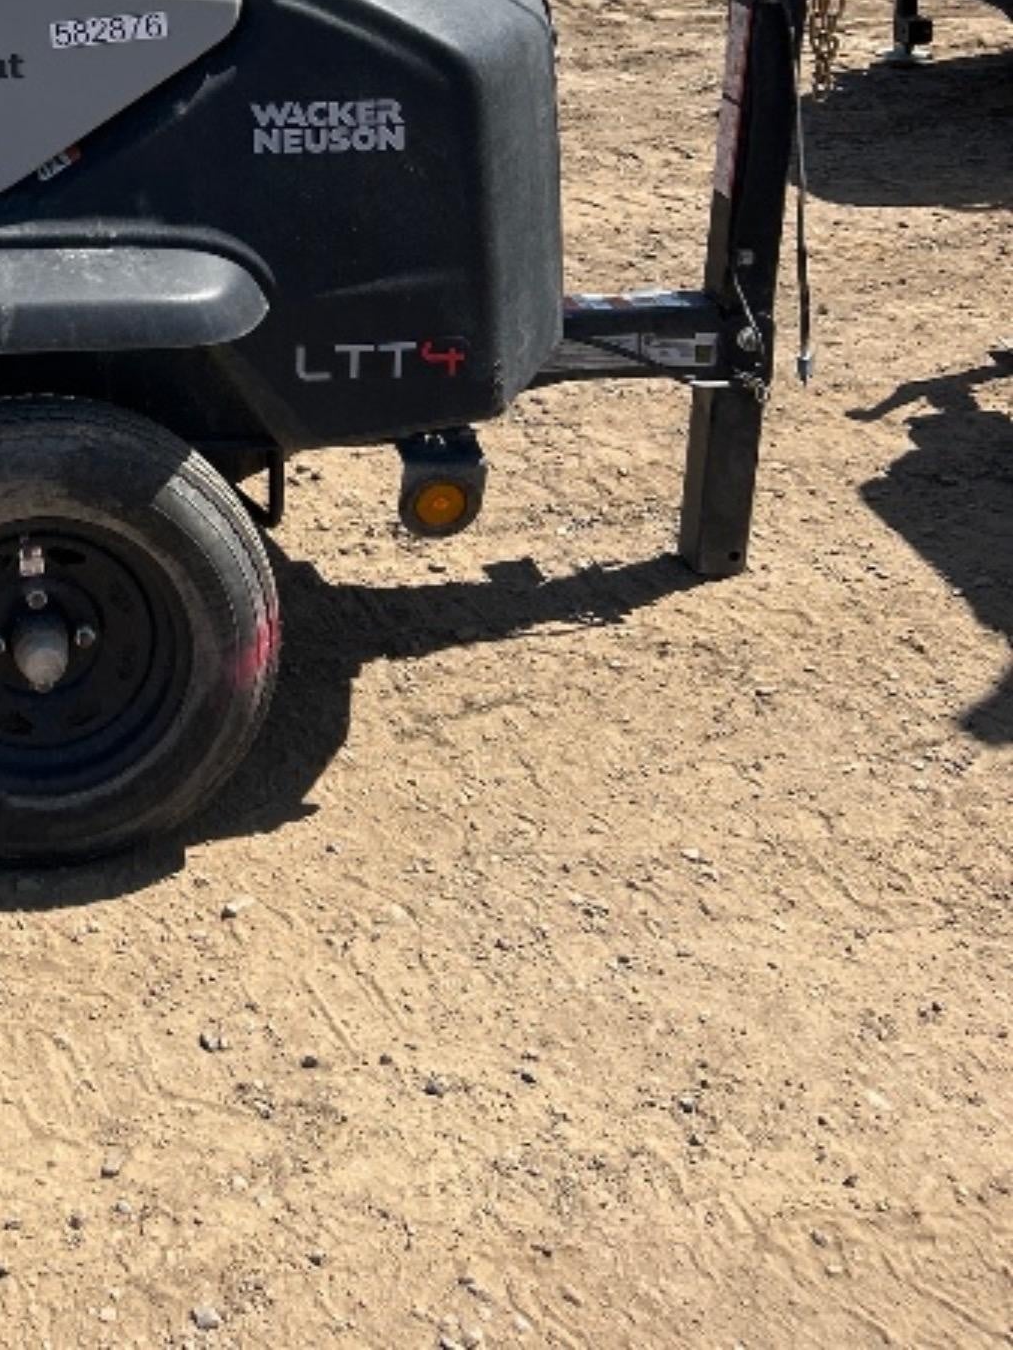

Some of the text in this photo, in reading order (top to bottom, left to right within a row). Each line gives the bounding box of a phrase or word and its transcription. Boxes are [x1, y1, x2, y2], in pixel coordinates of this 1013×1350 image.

[54, 13, 163, 47] 582876
[250, 98, 405, 127] WACKER
[253, 125, 406, 154] NEUSON
[295, 341, 465, 381] LTT4
